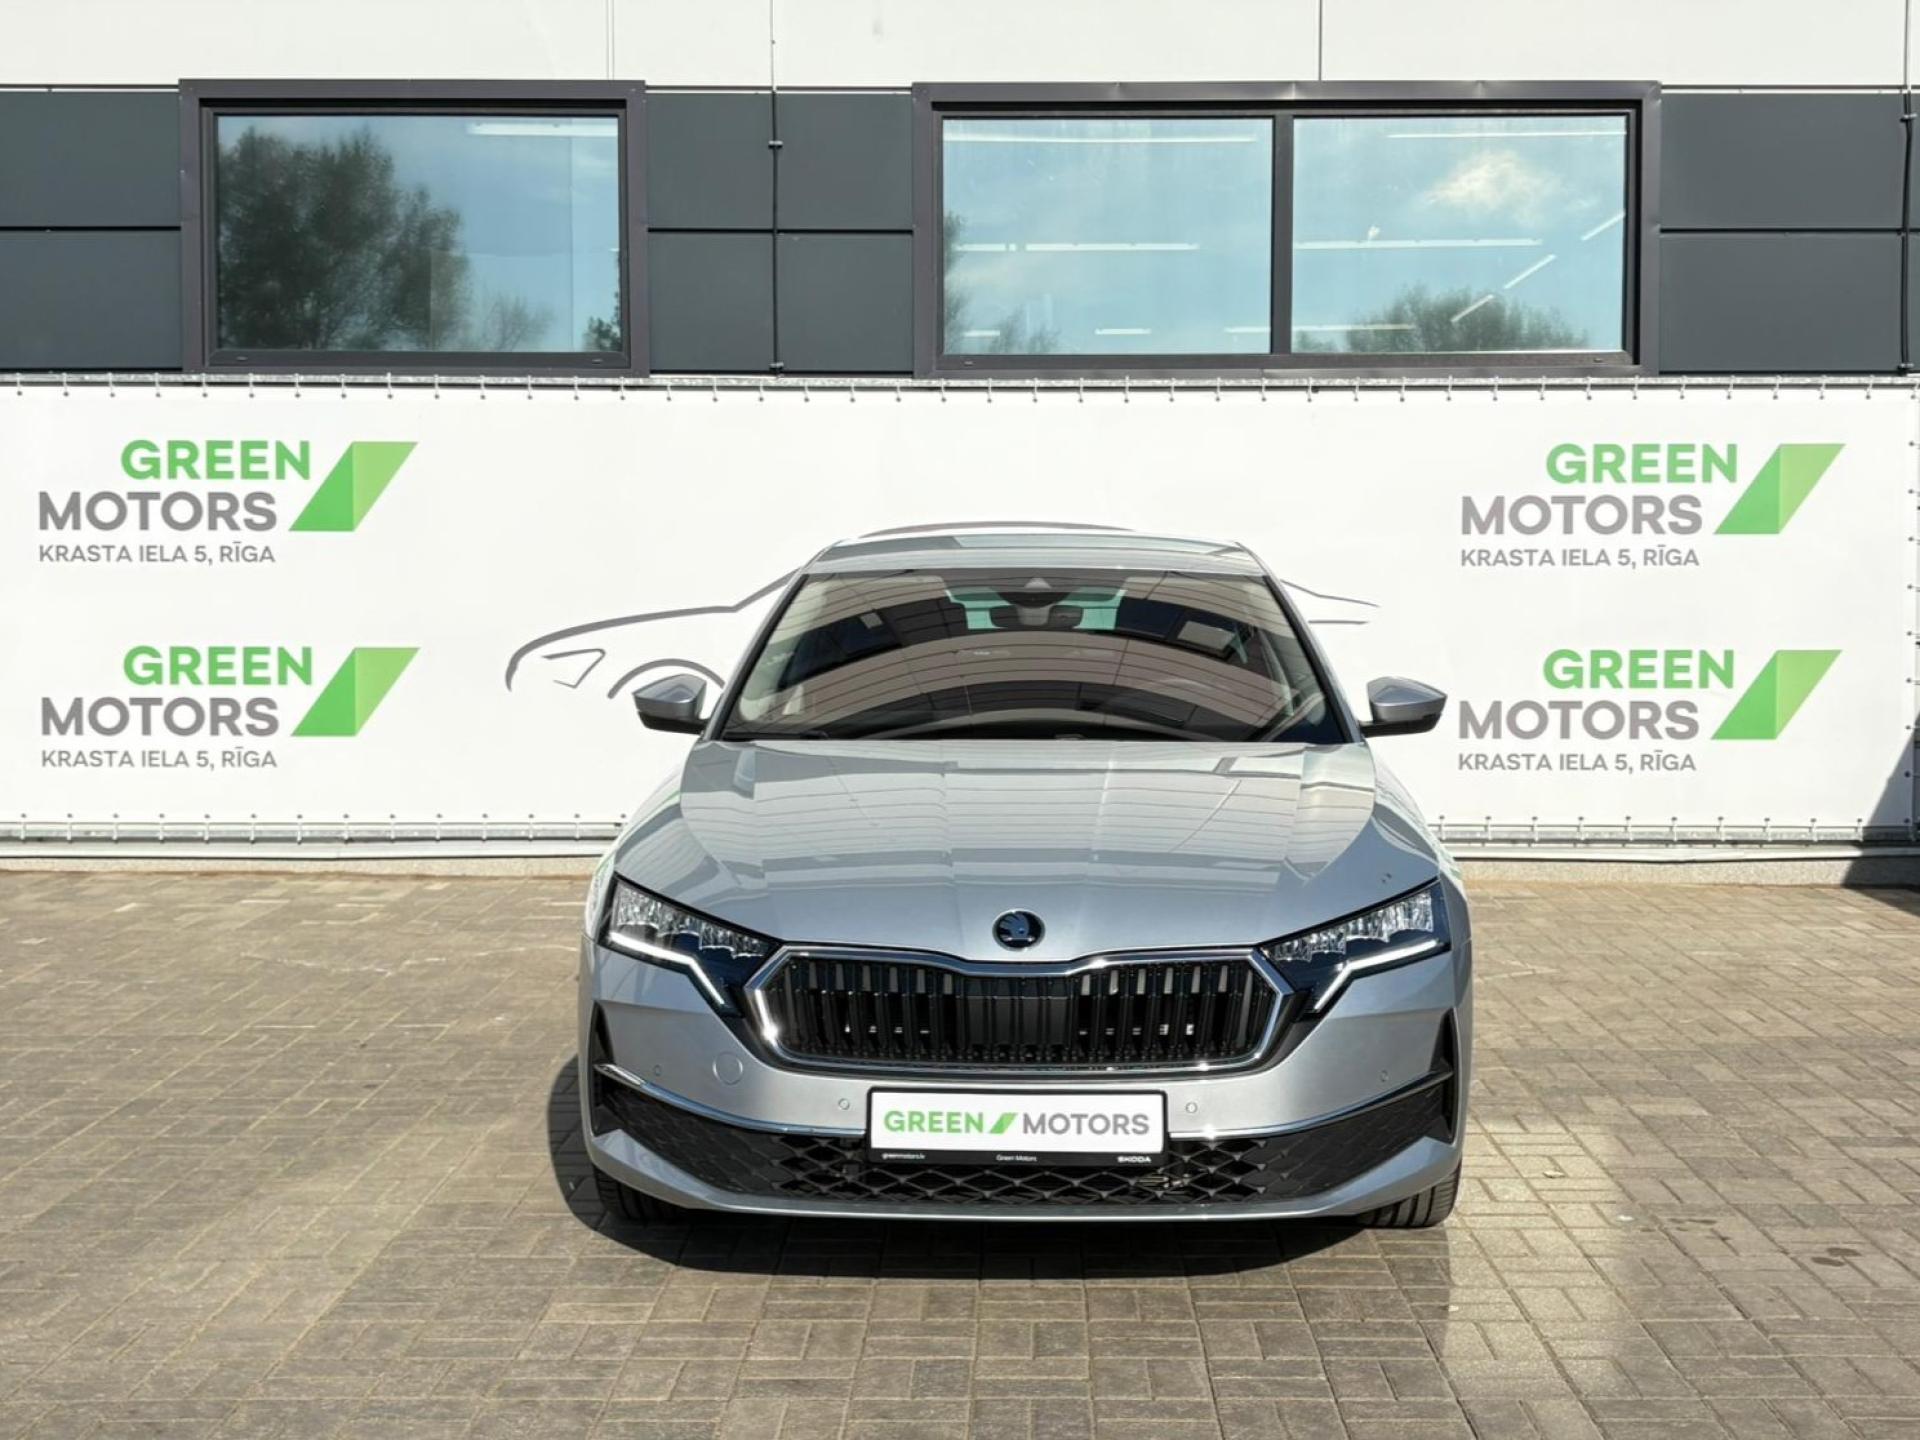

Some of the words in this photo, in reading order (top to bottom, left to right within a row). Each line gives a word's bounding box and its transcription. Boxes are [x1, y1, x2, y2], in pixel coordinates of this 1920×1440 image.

[120, 440, 310, 480] GREEN
[1546, 443, 1737, 484] GREEN
[39, 491, 277, 531] MOTORS
[1462, 495, 1702, 535] MOTORS
[40, 545, 132, 562] KRASTA
[140, 545, 188, 562] IELA
[195, 545, 212, 565] 5,
[220, 541, 275, 562] RĪGA
[1462, 549, 1555, 566] KRASTA
[1562, 549, 1610, 566] IELA
[1618, 549, 1636, 569] 5,
[1644, 545, 1699, 566] RĪGA
[123, 645, 313, 686] GREEN
[1543, 649, 1734, 689] GREEN
[42, 697, 279, 737] MOTORS
[1459, 700, 1699, 740] MOTORS
[42, 750, 134, 767] KRASTA
[142, 751, 189, 767] IELA
[197, 751, 214, 770] 5,
[222, 747, 277, 768] RĪGA
[1459, 754, 1552, 770] KRASTA
[1560, 754, 1608, 770] IELA
[1615, 754, 1633, 774] 5,
[1641, 750, 1696, 771] RĪGA
[884, 1110, 984, 1133] GREEN
[1023, 1113, 1149, 1135] MOTORS
